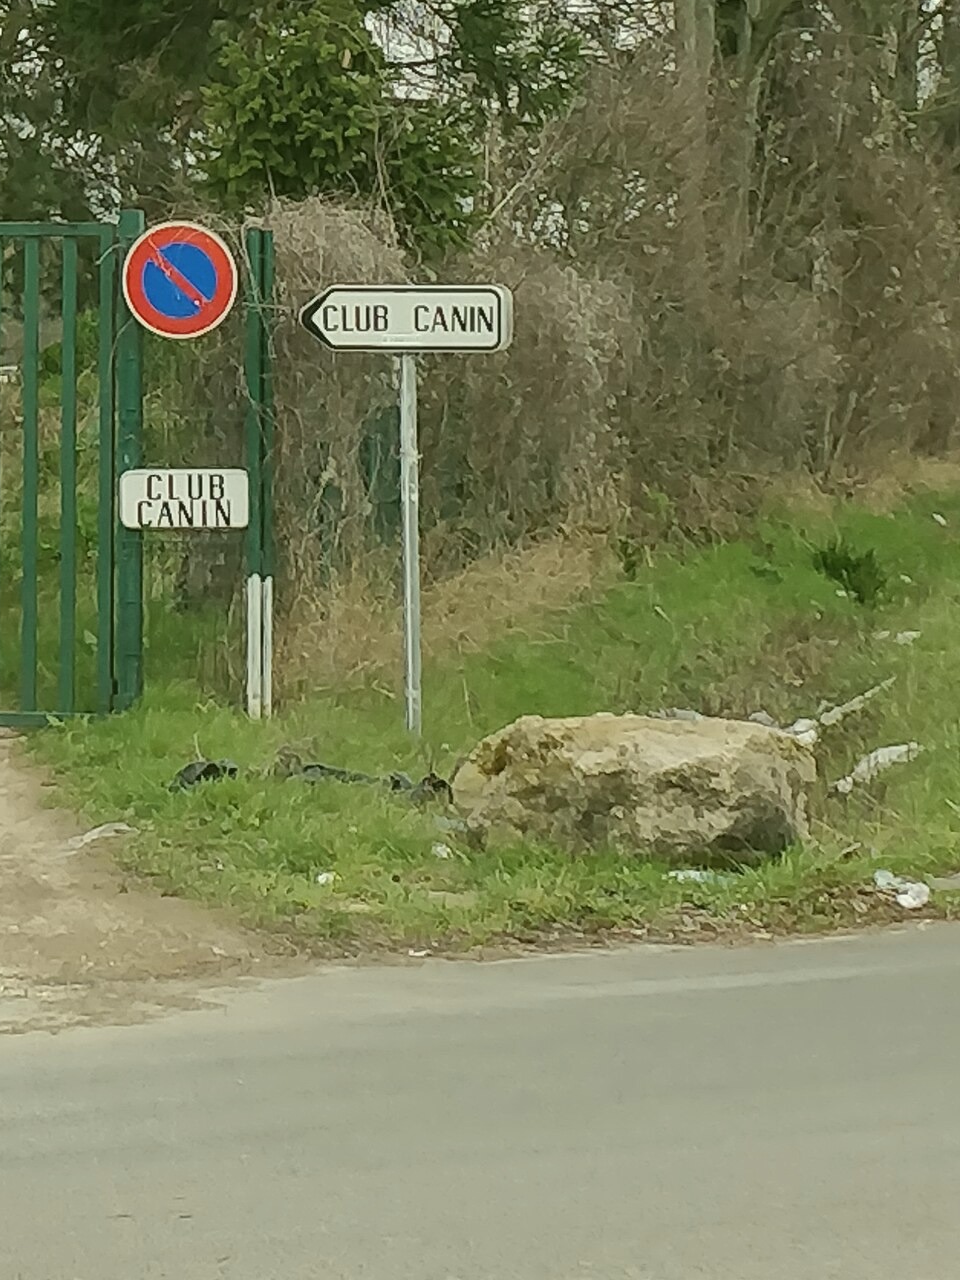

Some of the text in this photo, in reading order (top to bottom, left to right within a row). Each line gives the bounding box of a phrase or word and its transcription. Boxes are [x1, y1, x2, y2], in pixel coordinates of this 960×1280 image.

[322, 304, 494, 333] CLUB CANIN
[146, 473, 225, 500] CLUB
[137, 500, 231, 528] CANIN
